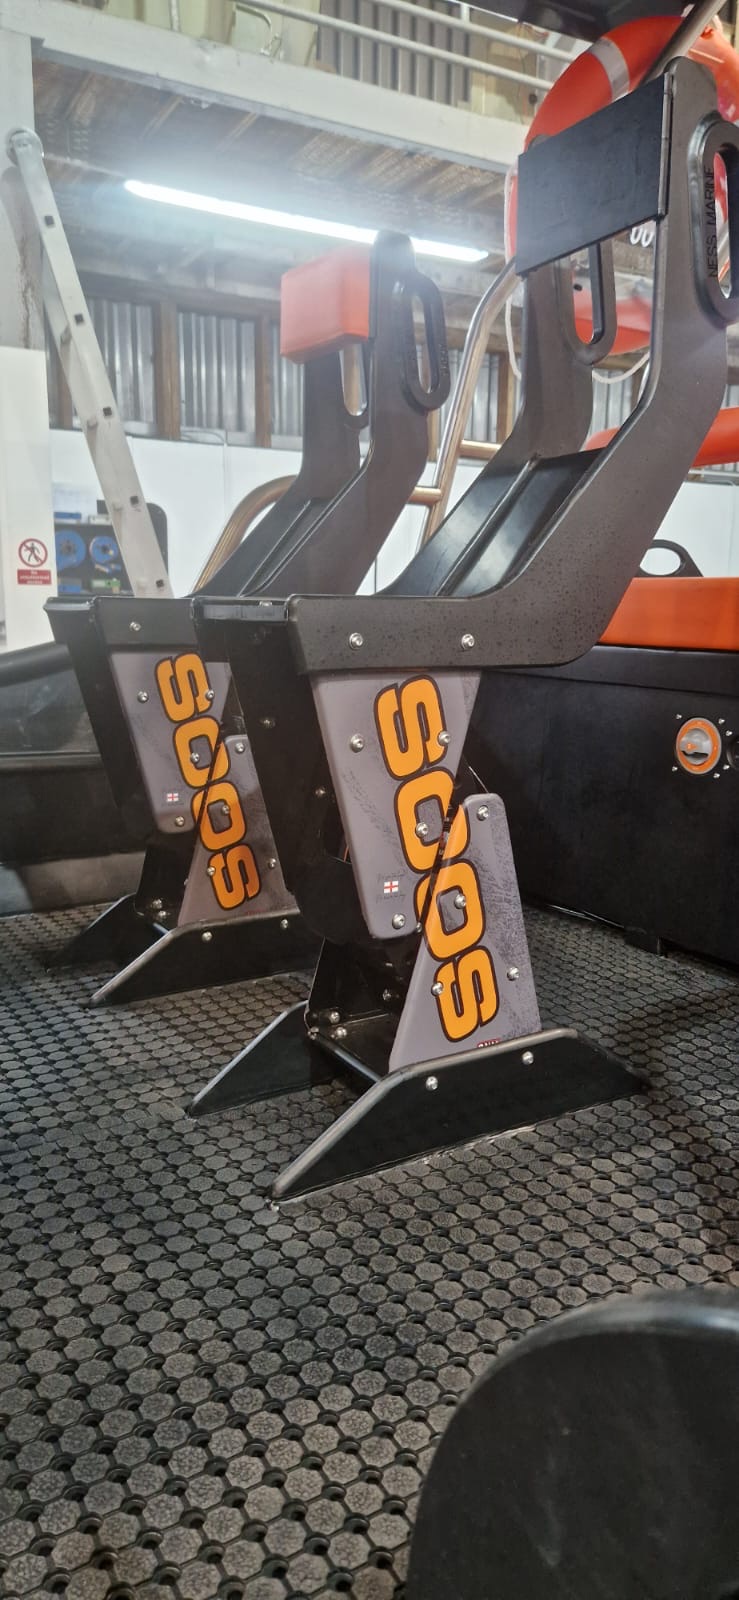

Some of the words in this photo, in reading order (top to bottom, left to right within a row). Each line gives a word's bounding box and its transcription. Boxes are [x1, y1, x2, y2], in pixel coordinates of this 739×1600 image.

[704, 167, 716, 227] MARINE
[706, 235, 718, 278] NESS
[374, 674, 500, 1042] SOOS
